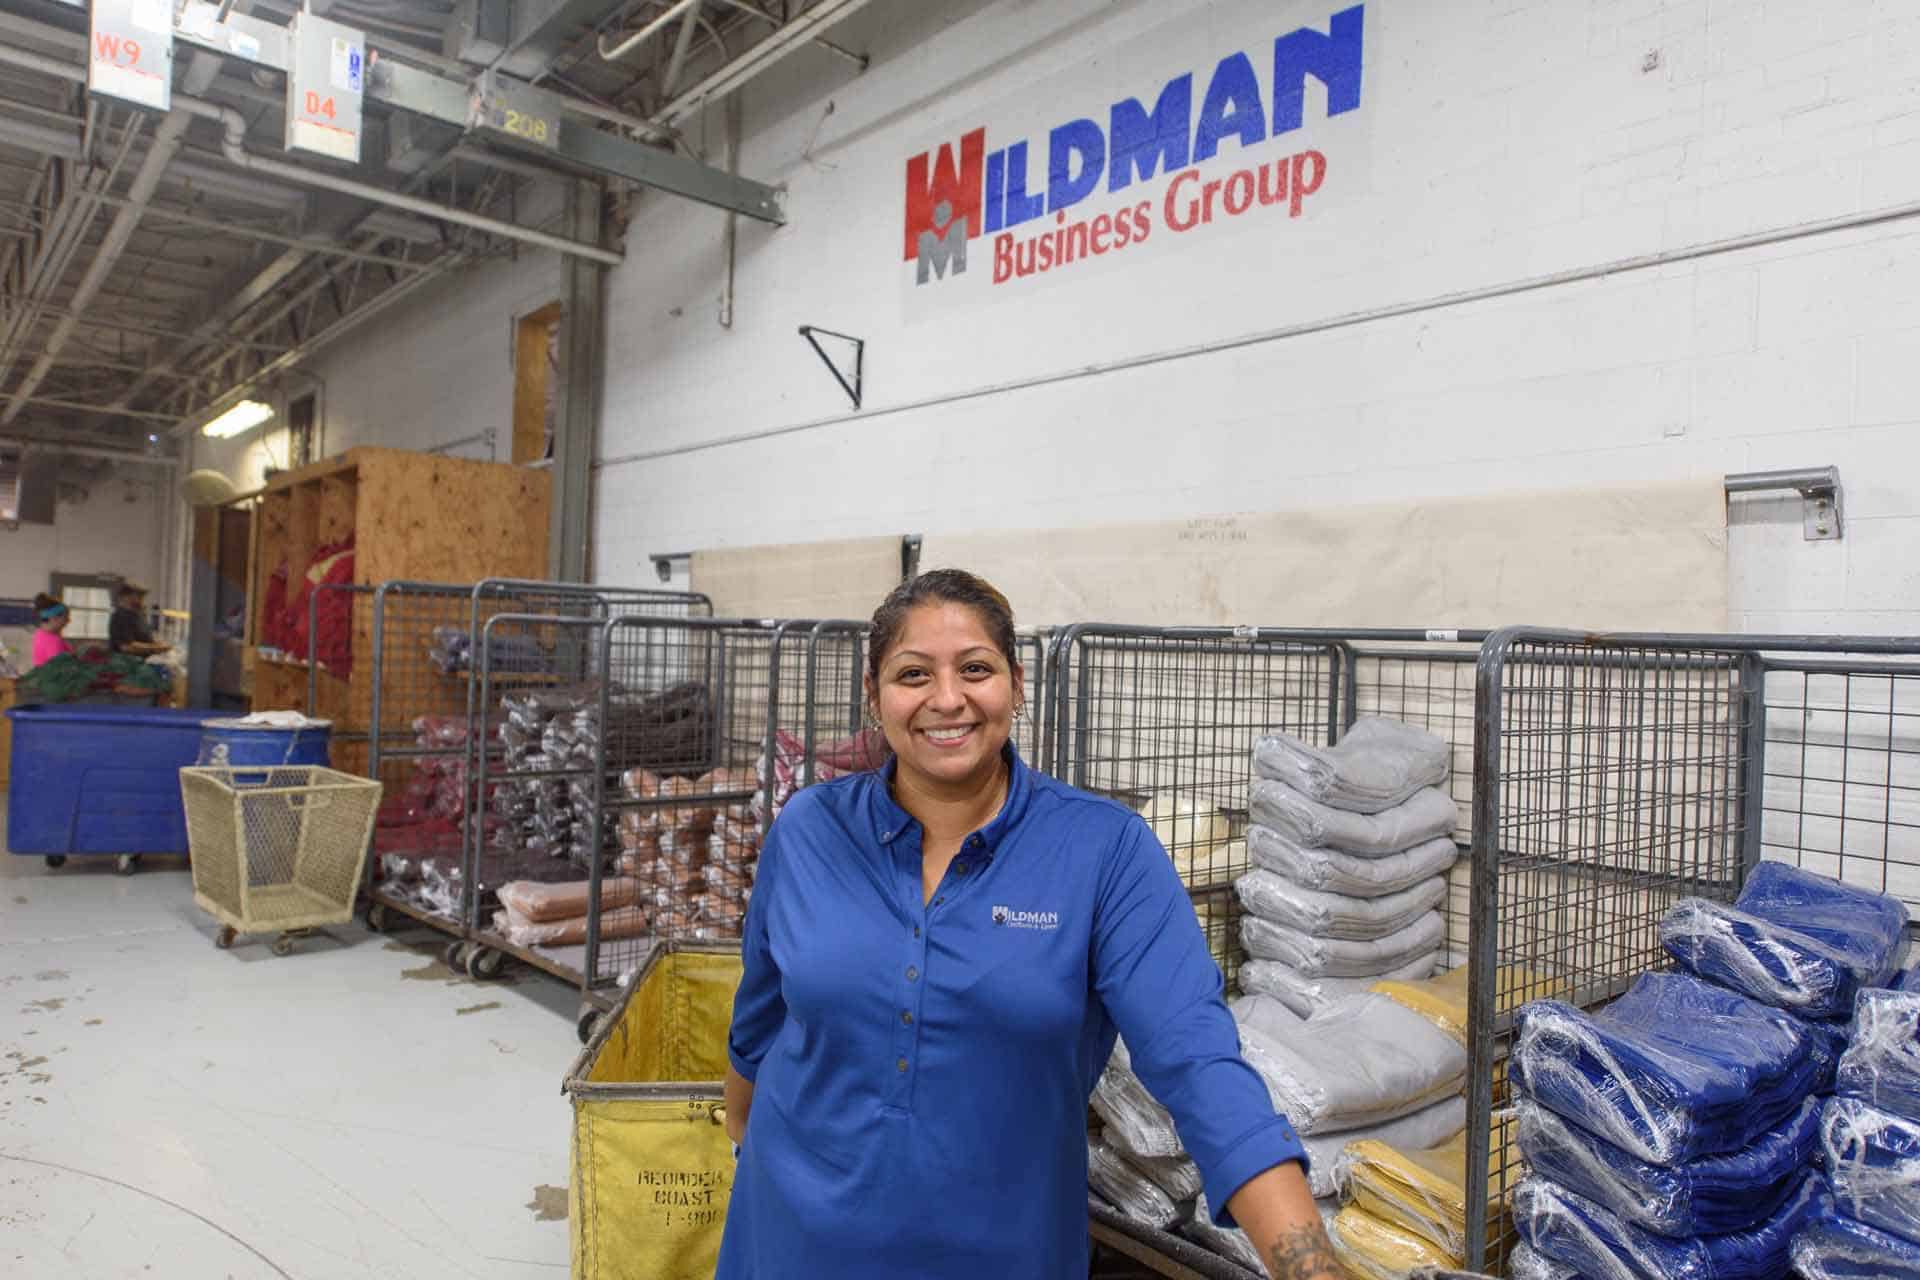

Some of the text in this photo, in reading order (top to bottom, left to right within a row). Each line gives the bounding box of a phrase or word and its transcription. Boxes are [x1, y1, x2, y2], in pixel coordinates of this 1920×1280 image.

[95, 31, 142, 65] W9
[304, 90, 337, 120] D4
[904, 3, 1365, 260] WILDMAN
[992, 149, 1328, 284] Business Group
[991, 905, 1058, 923] WILDMAN
[655, 1189, 715, 1207] COAST
